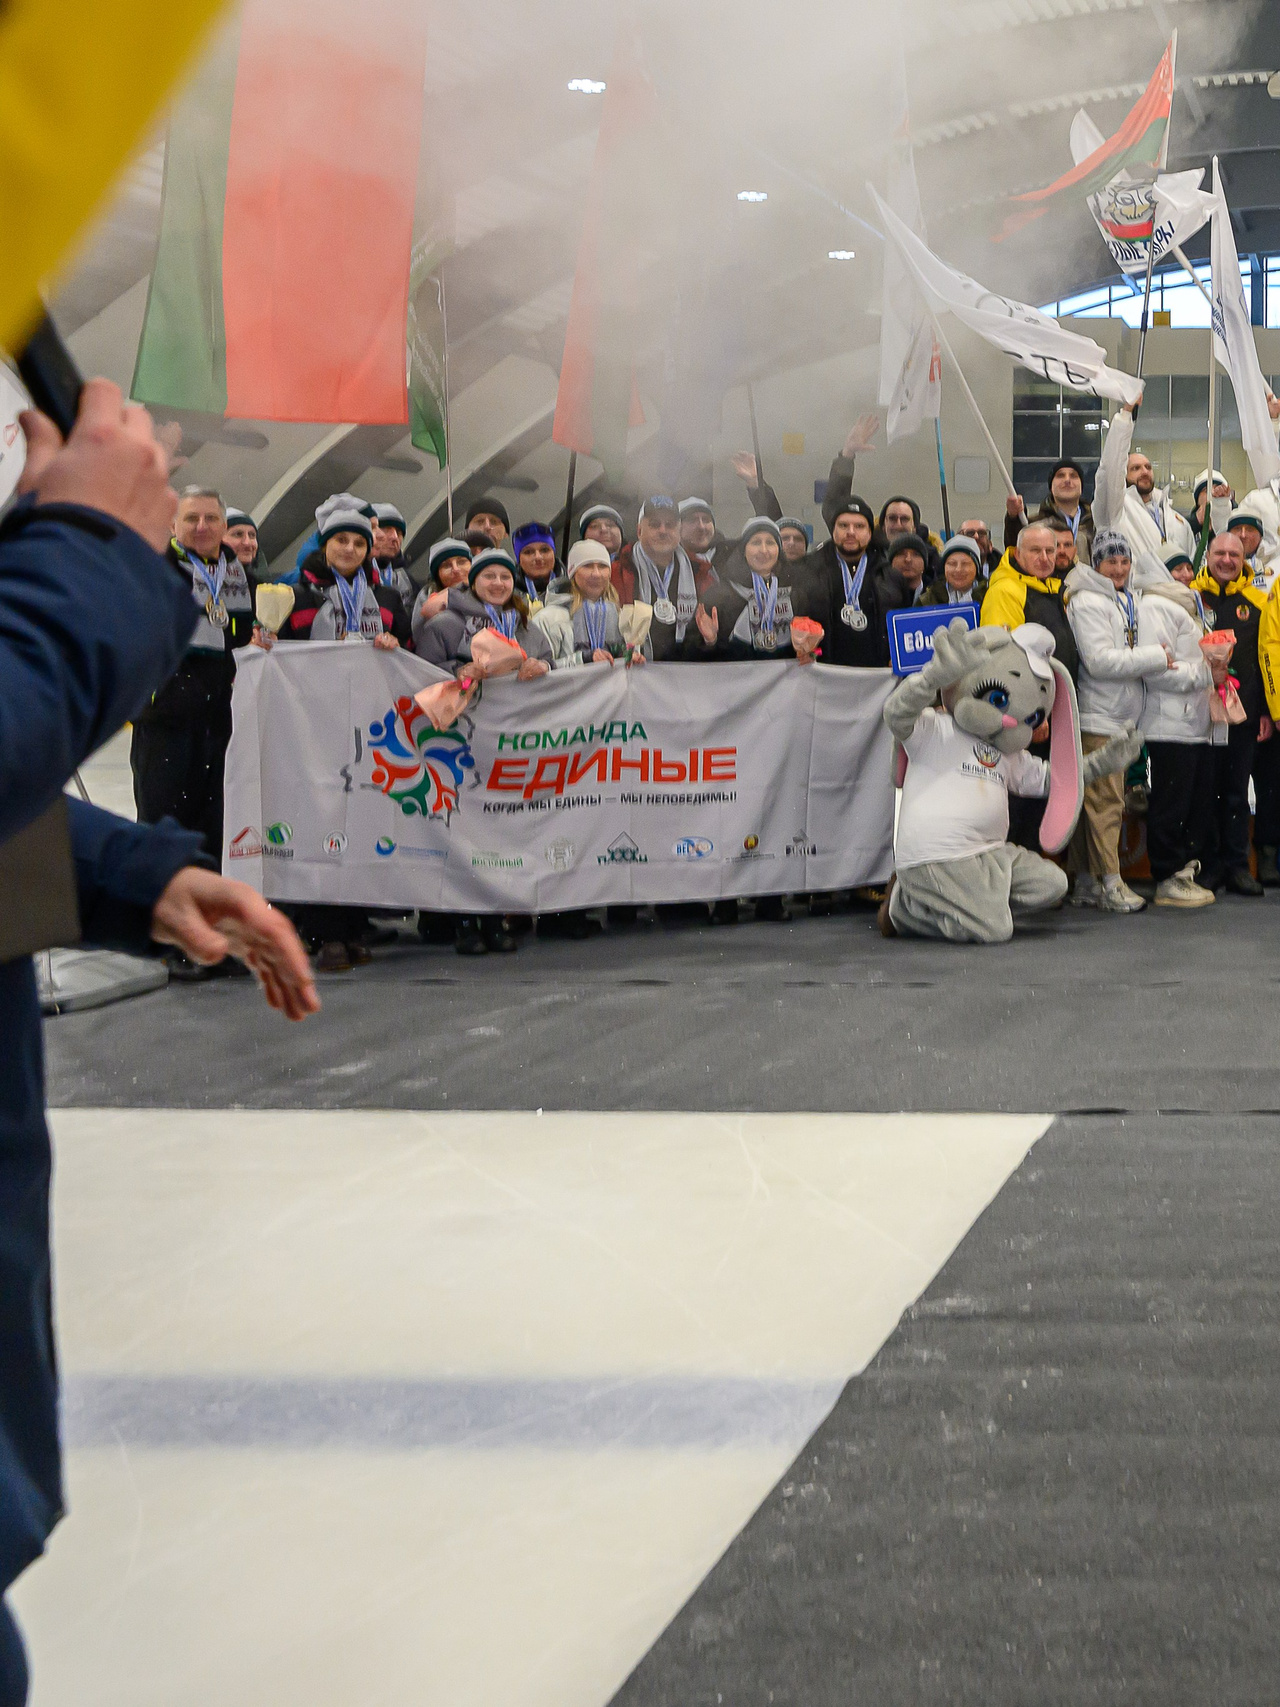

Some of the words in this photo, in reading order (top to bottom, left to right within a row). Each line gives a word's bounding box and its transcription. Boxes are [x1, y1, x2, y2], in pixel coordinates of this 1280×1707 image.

[498, 720, 648, 752] КОМАНДА
[486, 746, 738, 799] ЕДИНЫЕ
[483, 801, 525, 815] КОГДА
[528, 799, 551, 811] МЫ
[554, 795, 602, 809] ЕДИНЫ
[620, 792, 643, 805] МЫ
